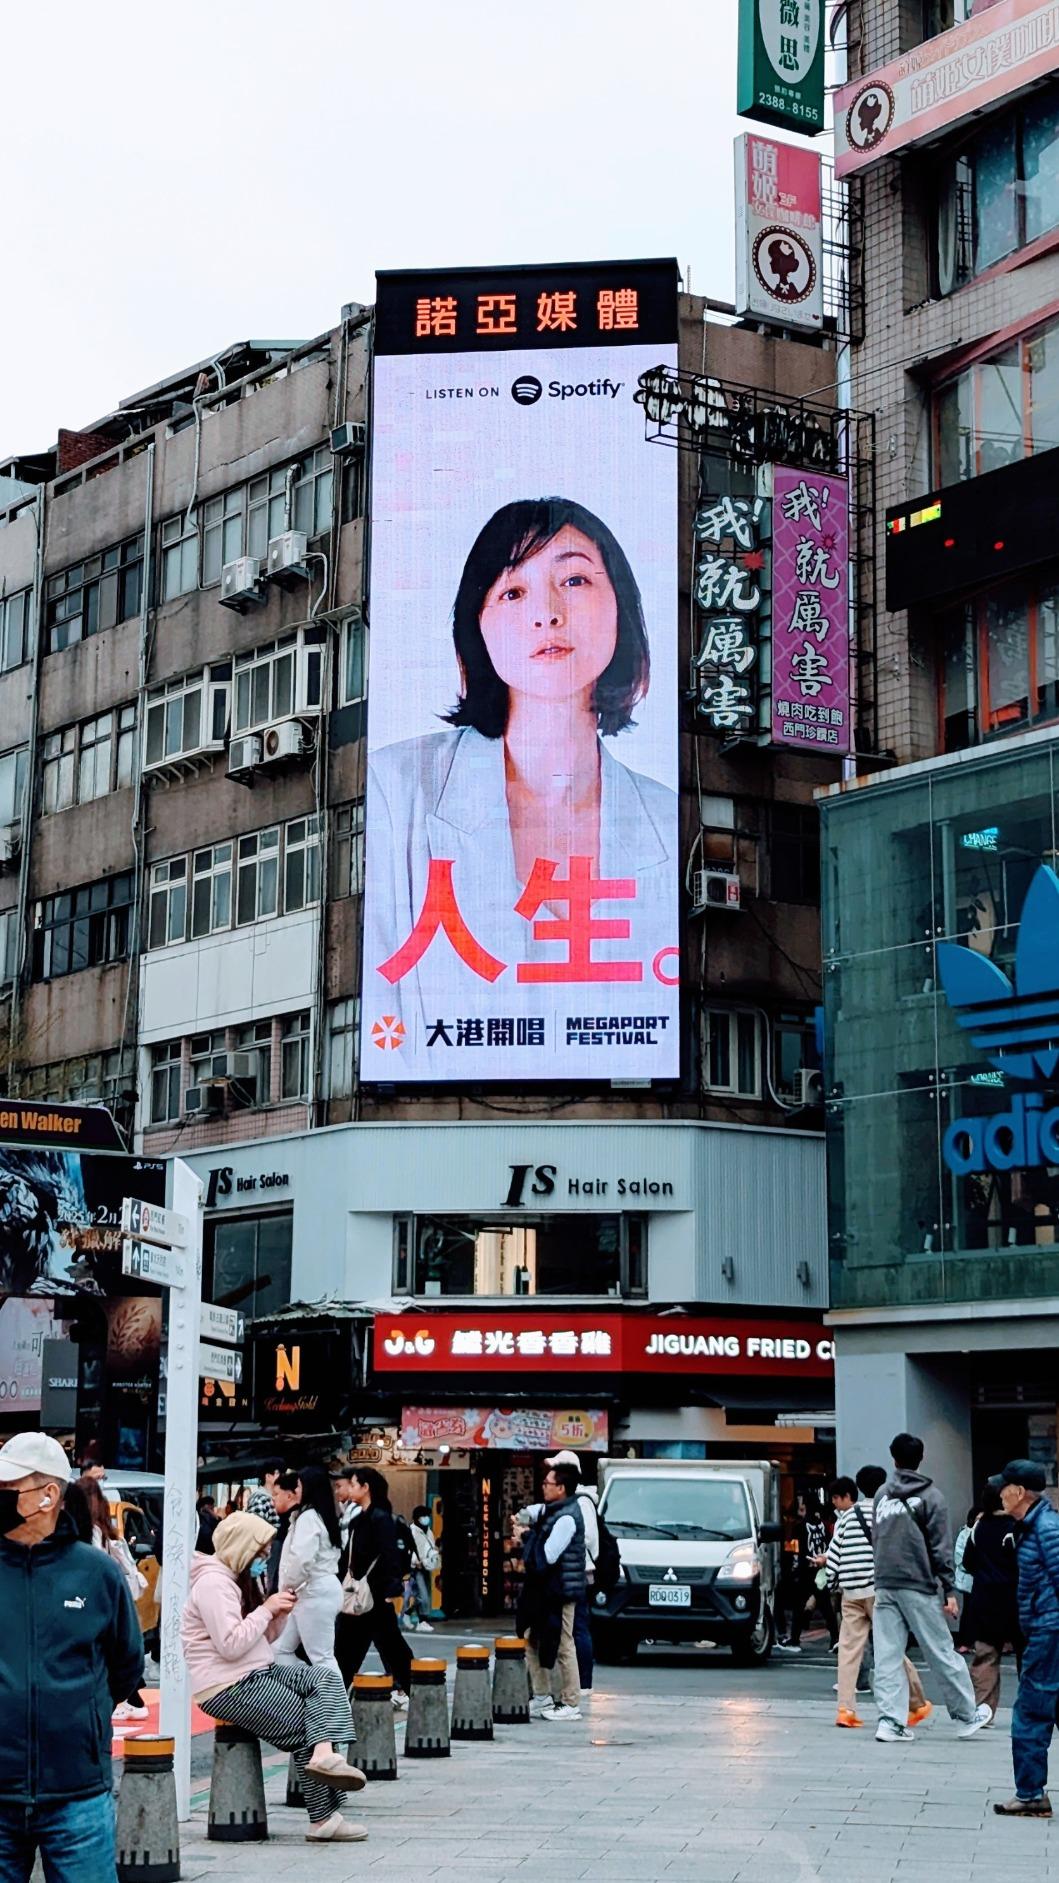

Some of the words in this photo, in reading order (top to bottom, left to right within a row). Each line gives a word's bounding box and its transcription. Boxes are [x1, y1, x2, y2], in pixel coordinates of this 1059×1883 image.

[758, 92, 819, 121] 2388-8155
[415, 288, 640, 337] 諾亞媒體
[426, 388, 474, 400] LISTEN
[478, 387, 500, 398] ON
[548, 379, 621, 401] Spotify
[425, 1018, 546, 1048] 大港開唱
[566, 1015, 670, 1031] MEGAPORT
[566, 1031, 659, 1046] FESTIVAL
[21, 1111, 82, 1133] Walker
[236, 1175, 257, 1192] Hair
[260, 1171, 289, 1189] Salon
[568, 1178, 608, 1195] Hair
[617, 1178, 673, 1195] Salon
[451, 1330, 612, 1355] 繼光香香雞
[645, 1333, 740, 1357] JIGUANG
[746, 1337, 812, 1359] FRIED
